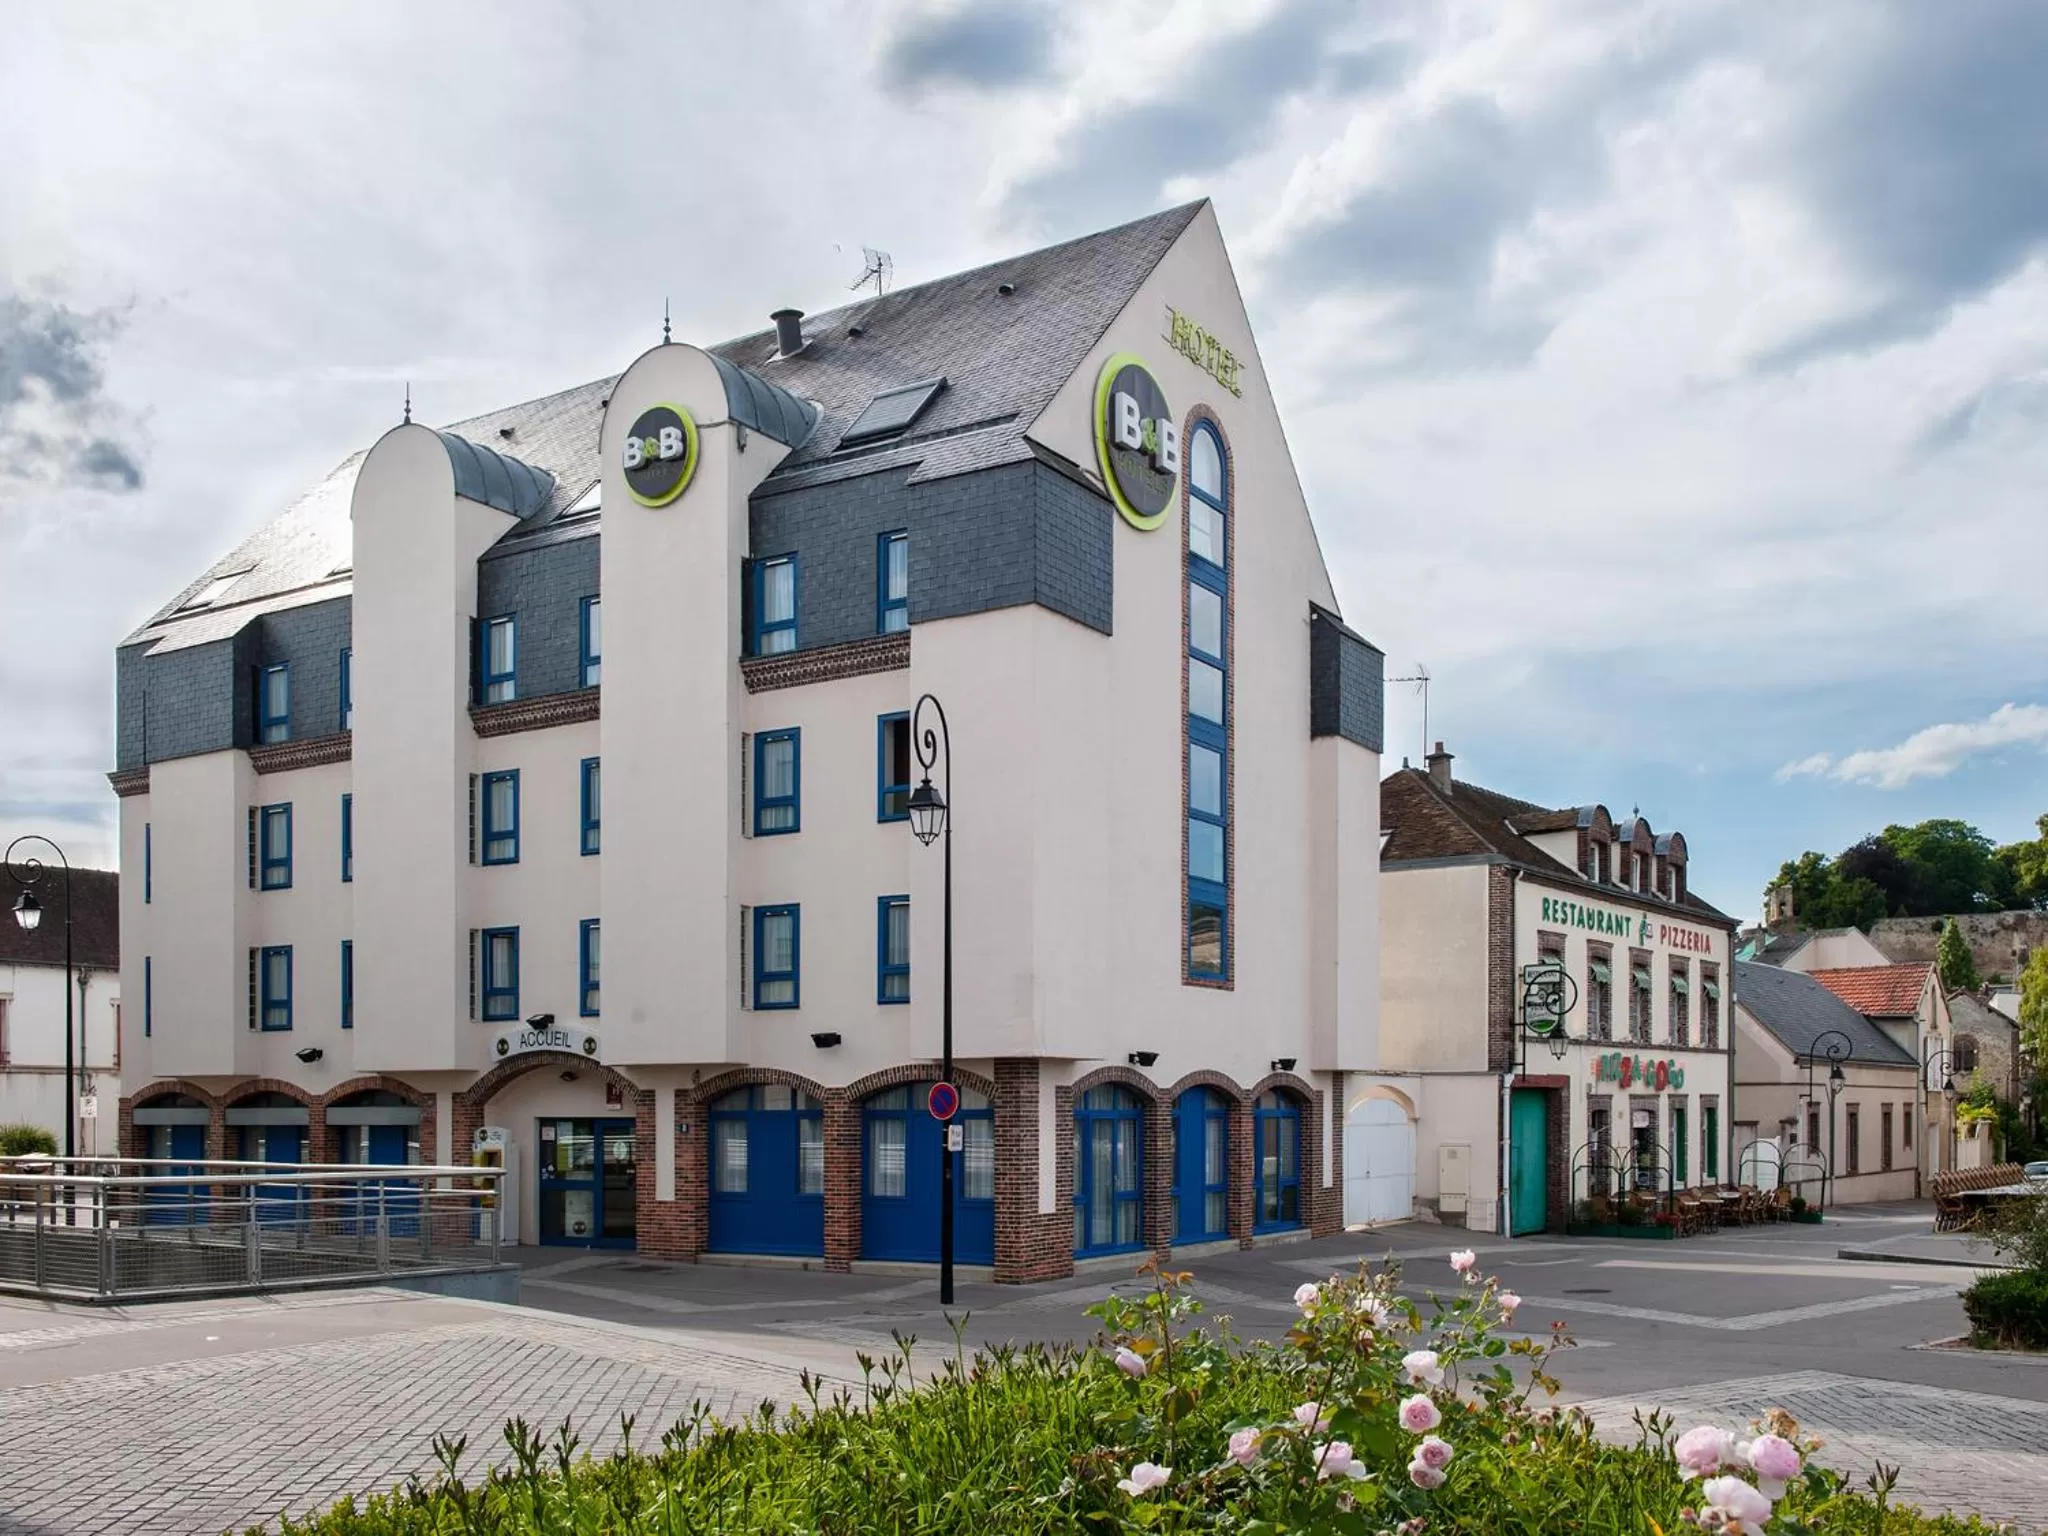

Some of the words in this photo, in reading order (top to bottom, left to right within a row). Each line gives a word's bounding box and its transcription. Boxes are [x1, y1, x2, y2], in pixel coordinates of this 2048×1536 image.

[1171, 309, 1243, 398] HOTEL
[623, 426, 684, 469] B&B
[1114, 391, 1179, 474] B&B
[1542, 897, 1632, 938] RESTAURANT
[1660, 924, 1712, 955] PIZZERIA
[519, 1030, 572, 1048] ACCUEIL
